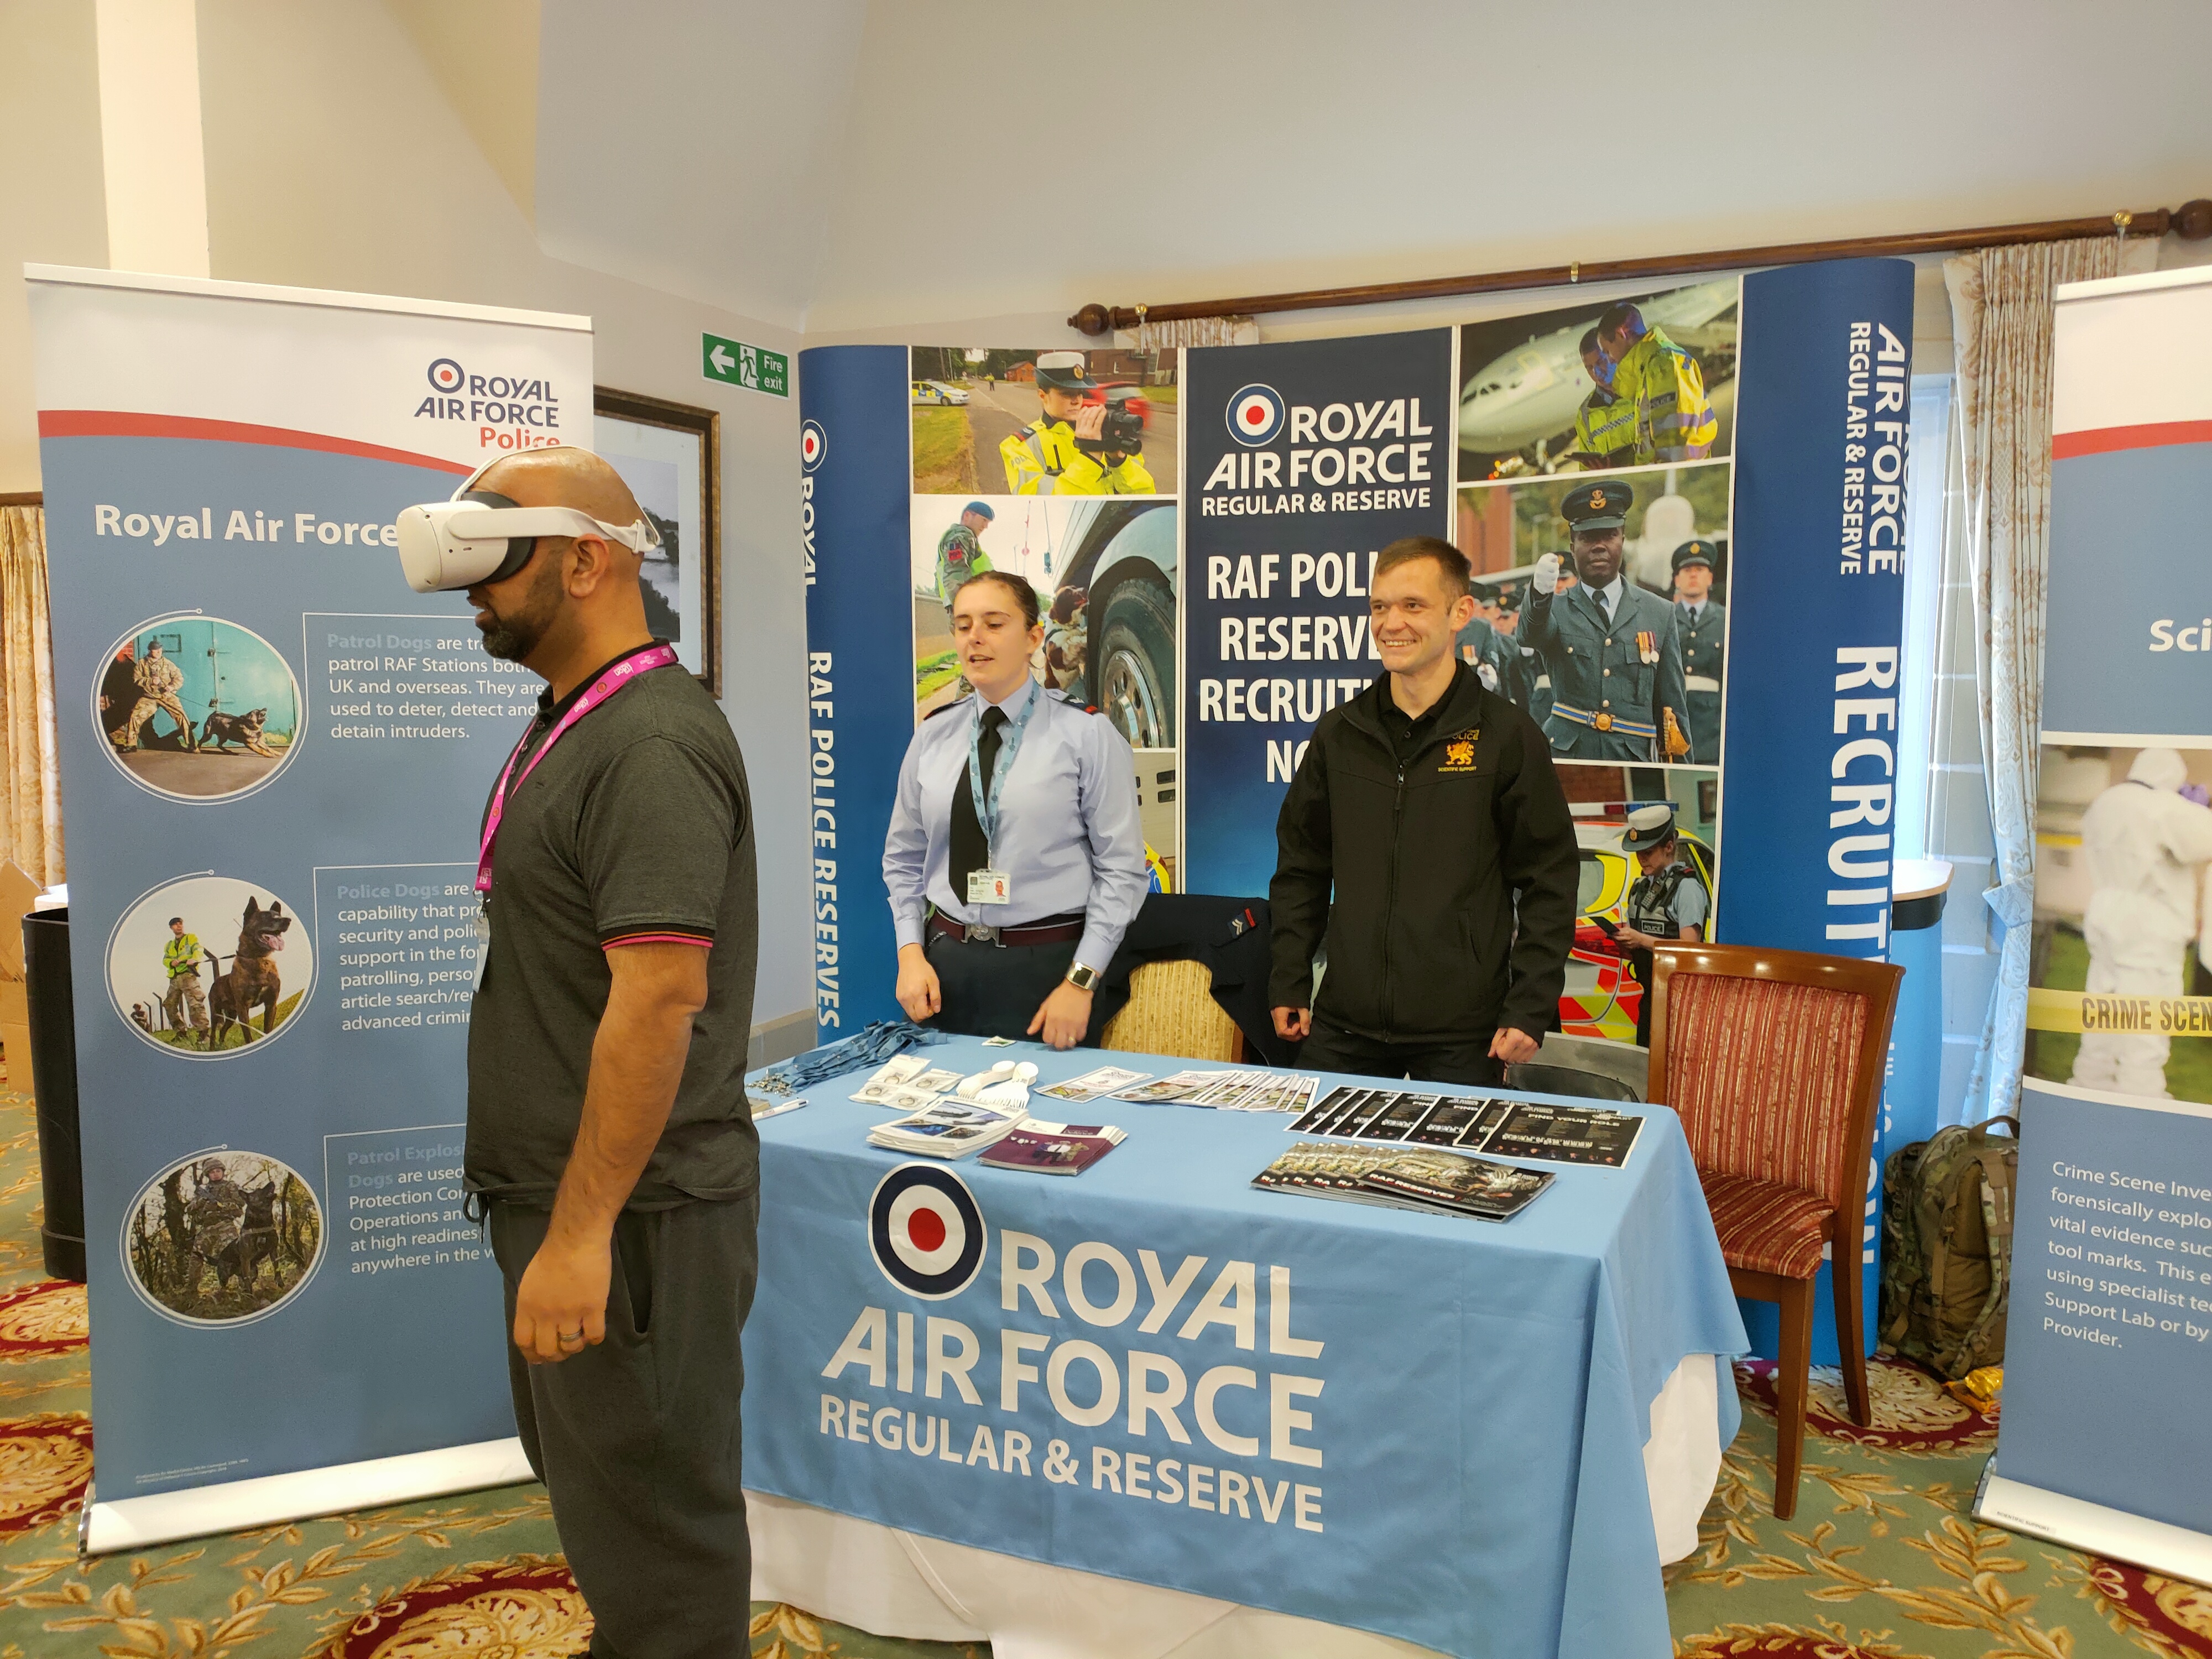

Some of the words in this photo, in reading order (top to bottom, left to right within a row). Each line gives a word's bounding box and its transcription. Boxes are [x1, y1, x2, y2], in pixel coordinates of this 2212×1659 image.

[764, 354, 783, 373] Fire
[1875, 322, 1905, 414] AIR
[470, 375, 559, 403] ROYAL
[764, 376, 782, 392] exit
[1846, 322, 1871, 440] REGULAR
[414, 397, 466, 420] AIR
[471, 401, 559, 427] FORCE
[1291, 398, 1433, 444] ROYAL
[1203, 452, 1282, 491] AIR
[1290, 442, 1432, 487] FORCE
[1845, 444, 1866, 462] &
[1203, 493, 1305, 517] REGULAR
[1310, 492, 1326, 513] &
[1332, 488, 1431, 512] RESERVE
[1868, 421, 1903, 575] FORCE
[95, 504, 212, 546] Royal
[225, 509, 284, 542] Air
[295, 513, 398, 546] Force
[1840, 468, 1865, 575] RESERVE
[1208, 554, 1280, 599] RAF
[327, 634, 382, 649] Patrol
[387, 635, 431, 653] Dogs
[437, 638, 462, 651] are
[2149, 618, 2211, 651] Sci
[328, 656, 378, 674] patrol
[384, 657, 417, 671] RAF
[422, 657, 487, 672] Stations
[330, 679, 353, 693] UK
[358, 679, 390, 694] and
[396, 683, 472, 695] overseas.
[476, 680, 515, 697] They
[520, 684, 545, 695] are
[810, 652, 833, 719] RAF
[1199, 679, 1373, 722] RECRUIT
[330, 701, 371, 716] used
[377, 704, 393, 716] to
[399, 701, 446, 718] deter,
[451, 702, 503, 716] detect
[508, 702, 538, 716] and
[331, 723, 385, 739] detain
[390, 723, 470, 739] intruders.
[811, 730, 836, 849] POLICE
[1825, 646, 1897, 963] RECRUIT
[337, 884, 390, 900] Police
[395, 884, 440, 900] Dogs
[444, 885, 469, 896] are
[338, 905, 418, 924] capability
[422, 904, 455, 919] that
[338, 928, 404, 945] security
[408, 925, 439, 939] and
[815, 860, 840, 1029] RESERVES
[340, 949, 405, 968] support
[410, 948, 424, 962] in
[429, 946, 456, 961] the
[341, 970, 424, 991] patrolling,
[341, 992, 392, 1009] article
[2082, 998, 2152, 1030] CRIME
[342, 1011, 422, 1031] advanced
[347, 1147, 400, 1166] Patrol
[348, 1173, 393, 1189] Dogs
[398, 1170, 422, 1183] are
[427, 1164, 464, 1181] used
[2053, 1161, 2105, 1184] Crime
[2110, 1171, 2166, 1194] Scene
[2171, 1181, 2212, 1201] Inve
[349, 1190, 432, 1209] Protection
[2051, 1187, 2154, 1222] forensically
[2158, 1209, 2211, 1229] explo
[349, 1212, 439, 1233] Operations
[2049, 1215, 2085, 1234] vital
[2091, 1224, 2175, 1250] evidence
[2180, 1241, 2212, 1258] suc
[350, 1240, 366, 1252] at
[371, 1233, 406, 1251] high
[351, 1254, 431, 1275] anywhere
[435, 1250, 449, 1263] in
[453, 1247, 480, 1261] the
[2048, 1240, 2082, 1260] tool
[2088, 1251, 2147, 1272] marks.
[2156, 1260, 2195, 1282] This
[1001, 1229, 1325, 1359] ROYAL
[2047, 1269, 2094, 1292] using
[2099, 1280, 2185, 1308] specialist
[2044, 1291, 2117, 1321] Support
[2121, 1308, 2155, 1328] Lab
[2160, 1319, 2182, 1333] or
[2185, 1321, 2209, 1342] by
[2043, 1317, 2122, 1348] Provider.
[821, 1306, 983, 1406] AIR
[1001, 1329, 1326, 1468] FORCE
[820, 1394, 1032, 1477] REGULAR
[1043, 1439, 1079, 1486] &
[1092, 1447, 1324, 1533] RESERVE
